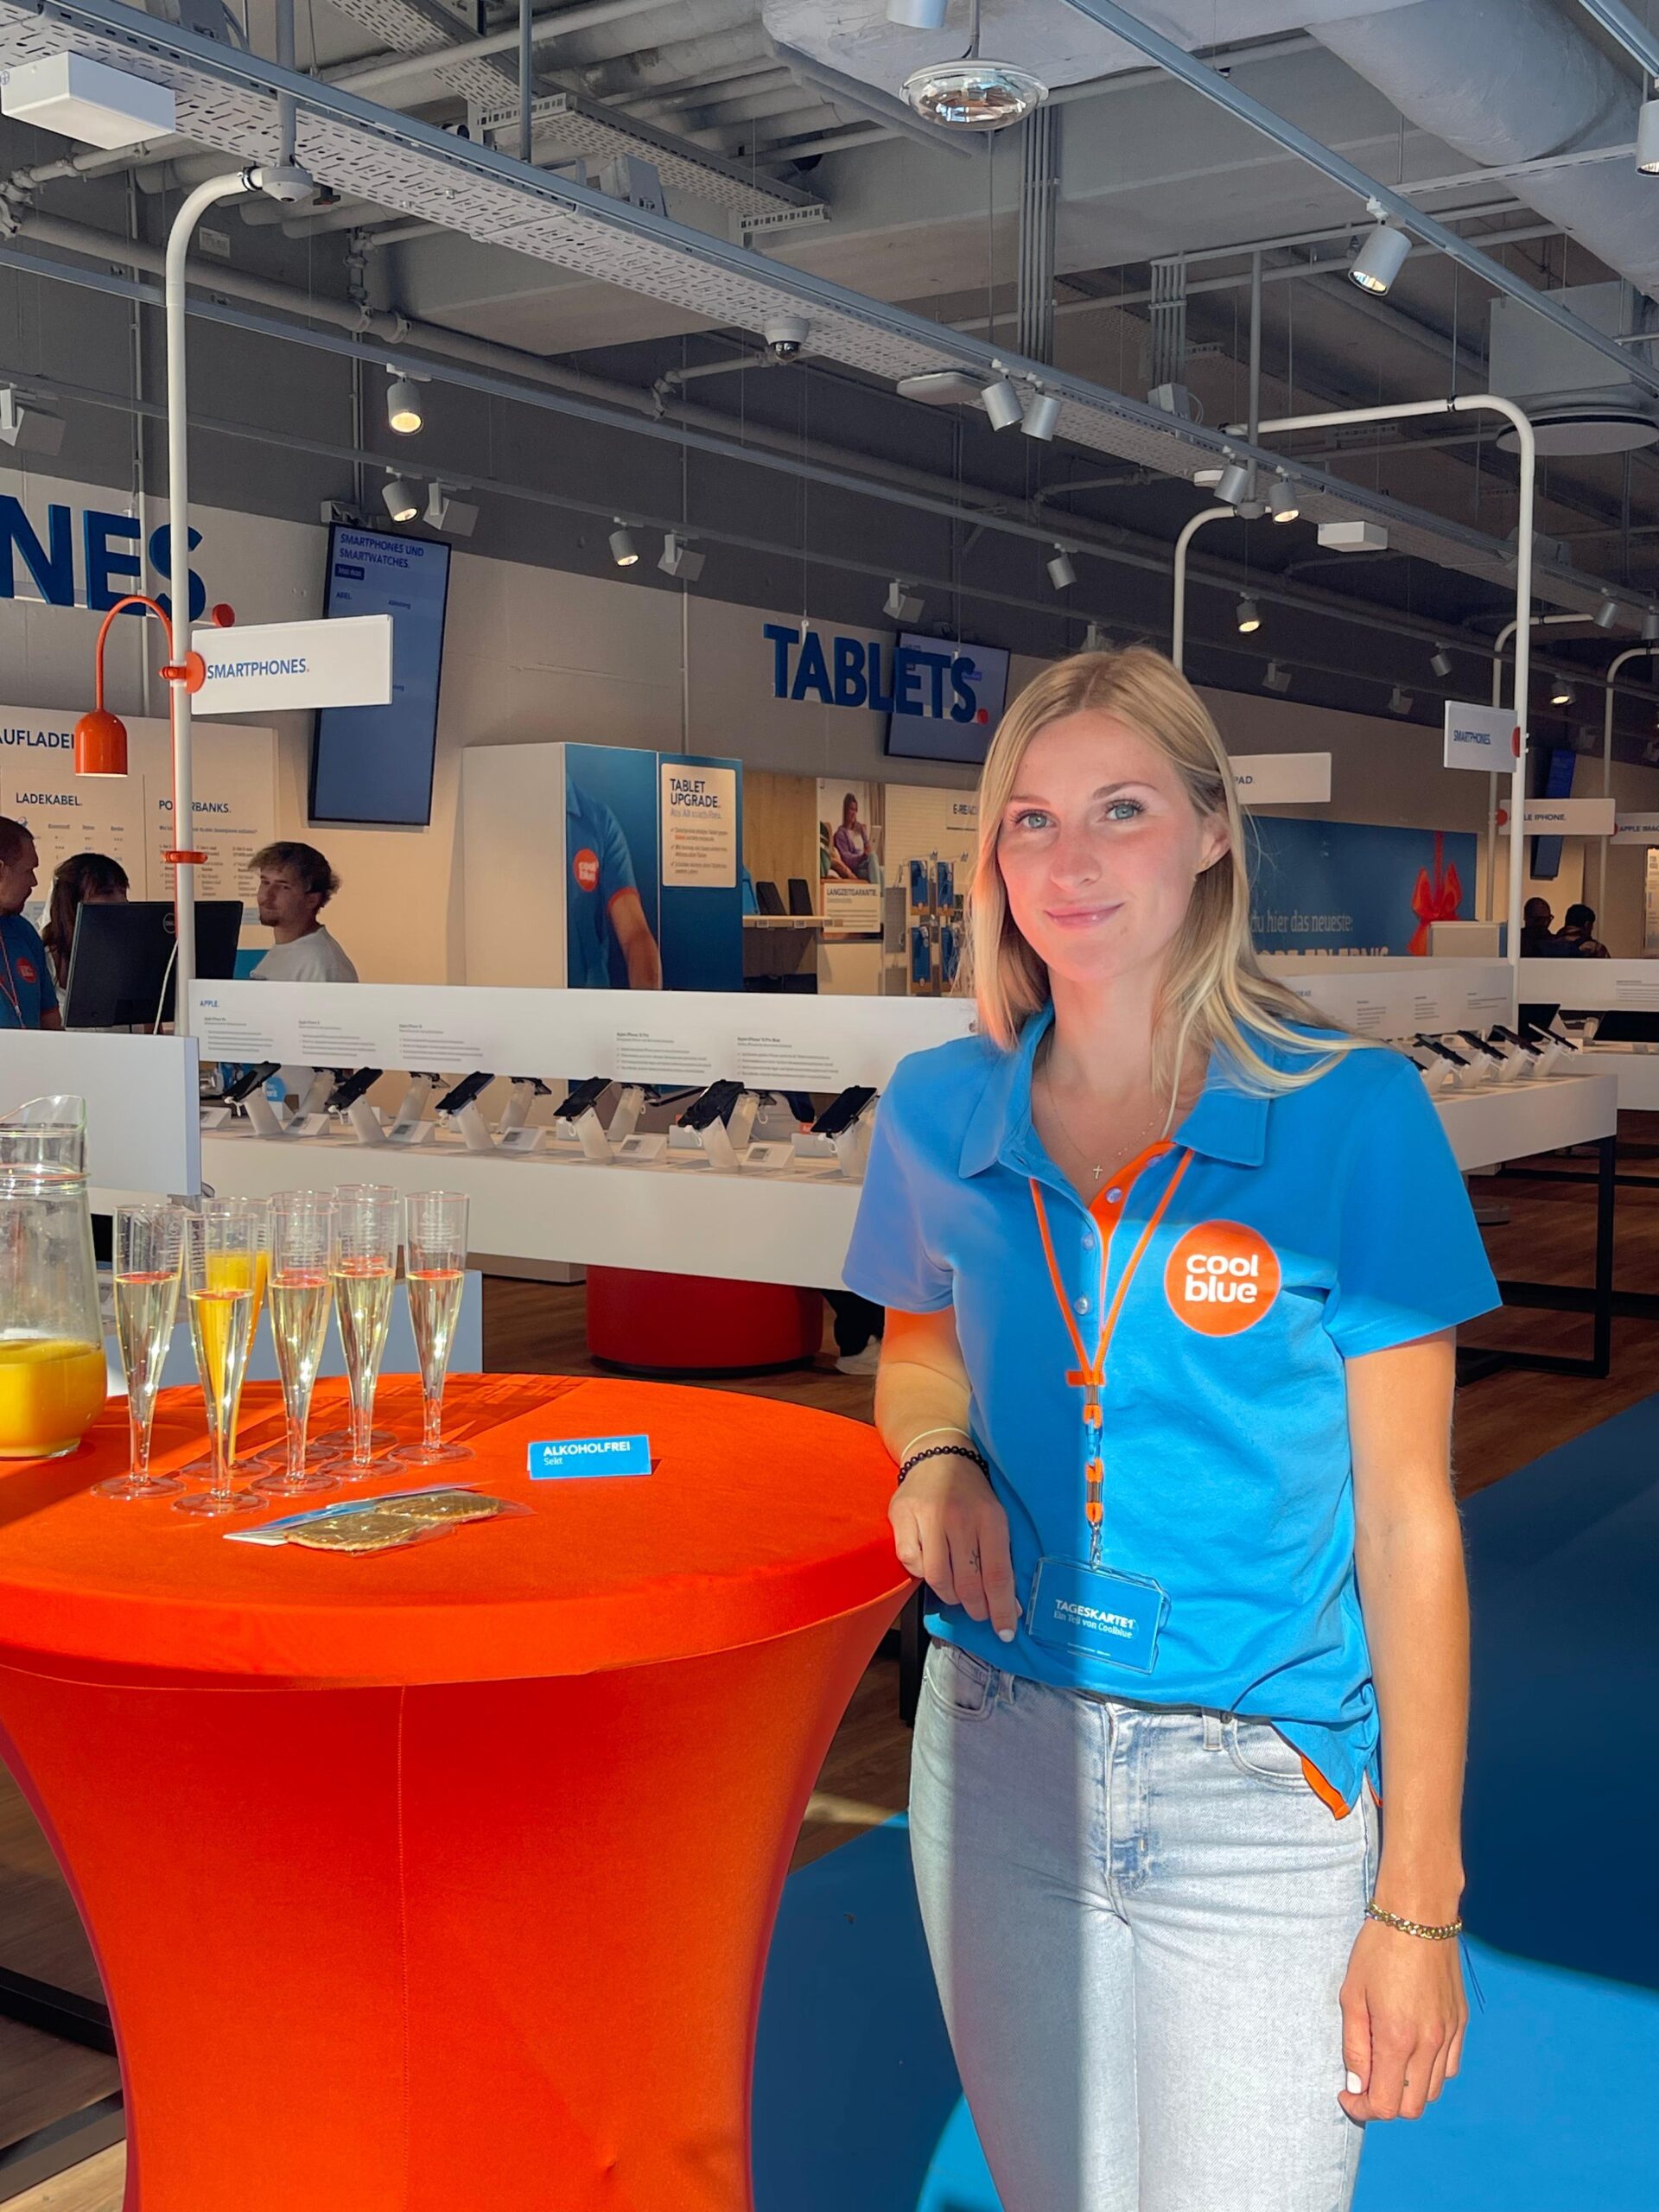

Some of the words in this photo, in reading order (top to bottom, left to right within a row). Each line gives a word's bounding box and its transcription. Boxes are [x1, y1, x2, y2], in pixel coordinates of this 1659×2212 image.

[340, 533, 404, 554] SMARTPHONES
[405, 545, 424, 557] UND
[207, 658, 309, 679] SMARTPHONES.
[764, 623, 988, 726] TABLETS.
[0, 728, 74, 749] UFLADE
[670, 779, 705, 793] TABLET
[16, 792, 83, 806] LADEKABEL.
[158, 800, 232, 814] PORBANKS.
[1267, 910, 1288, 932] hier
[1290, 910, 1309, 932] das
[1186, 1255, 1259, 1277] cool
[1185, 1274, 1257, 1303] blue
[543, 1441, 631, 1456] ALKOHOLFREI
[543, 1457, 563, 1465] Sekt
[1053, 1610, 1066, 1621] Ein
[1082, 1620, 1097, 1629] von
